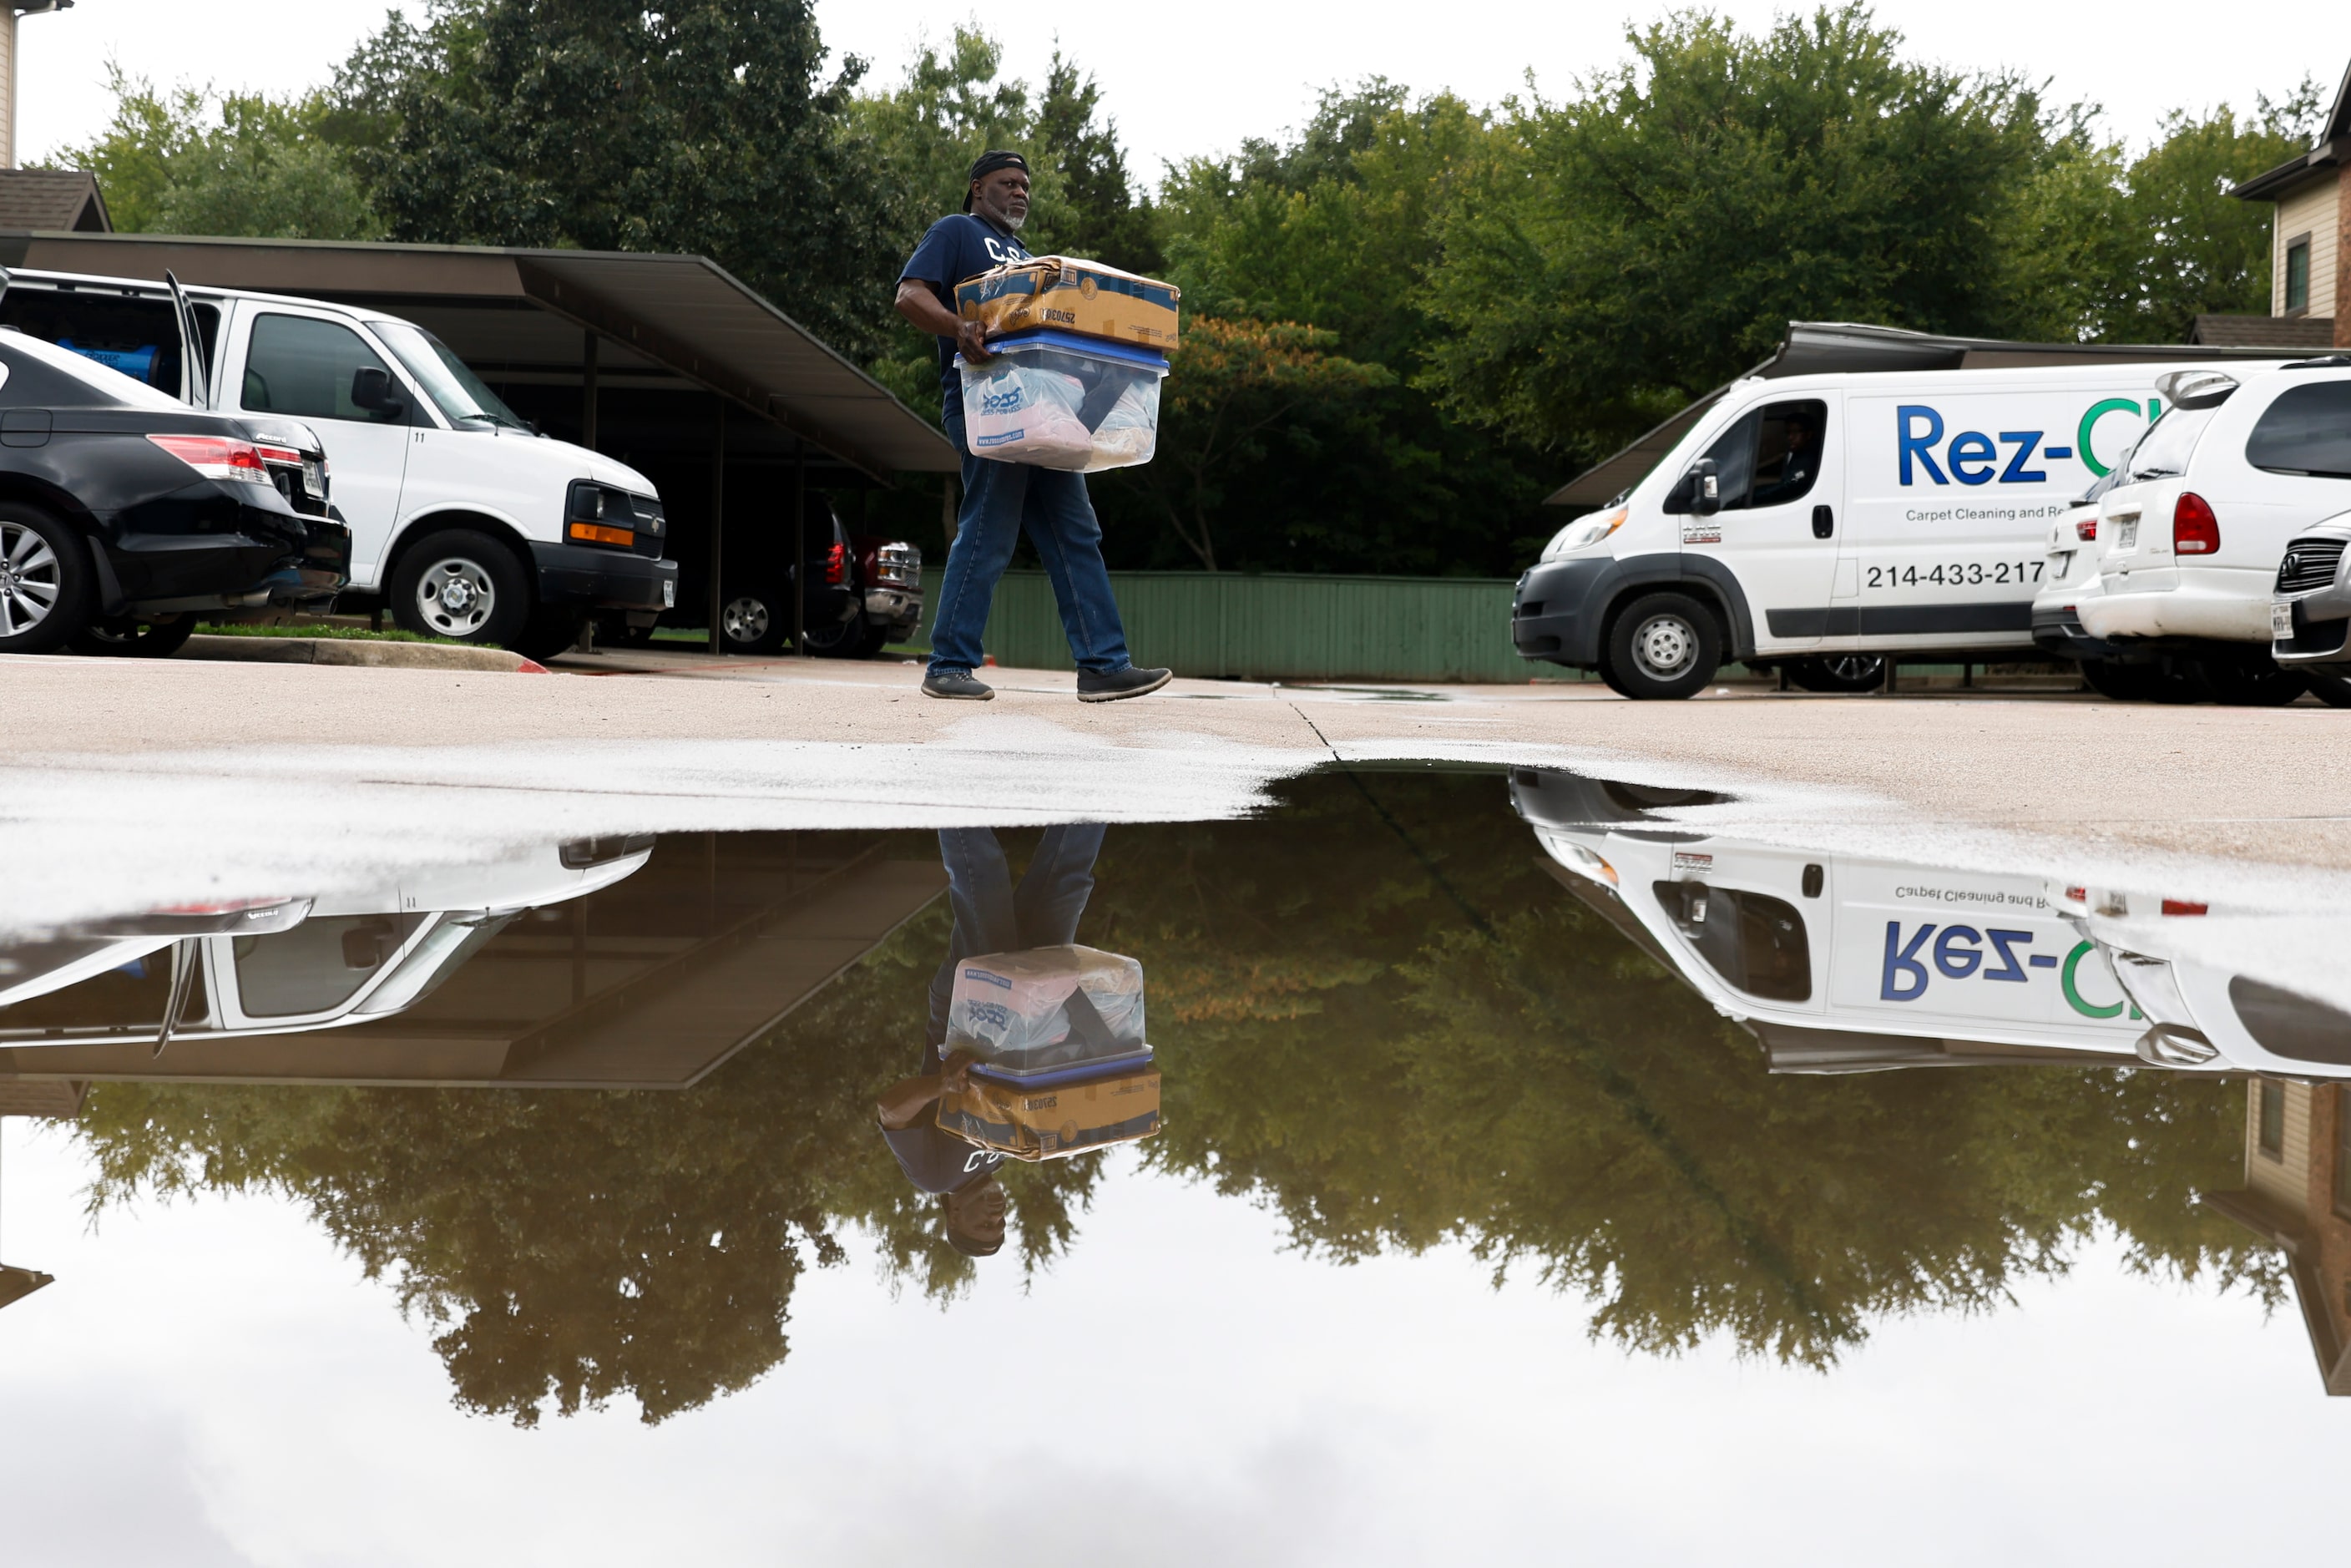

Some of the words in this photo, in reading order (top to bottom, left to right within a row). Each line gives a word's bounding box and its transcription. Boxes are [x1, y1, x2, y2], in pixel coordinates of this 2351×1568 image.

[255, 432, 286, 443] Accord
[415, 432, 424, 443] 11
[1906, 509, 1951, 523] Carpet
[1955, 508, 2015, 521] Cleaning
[2019, 508, 2044, 518] and
